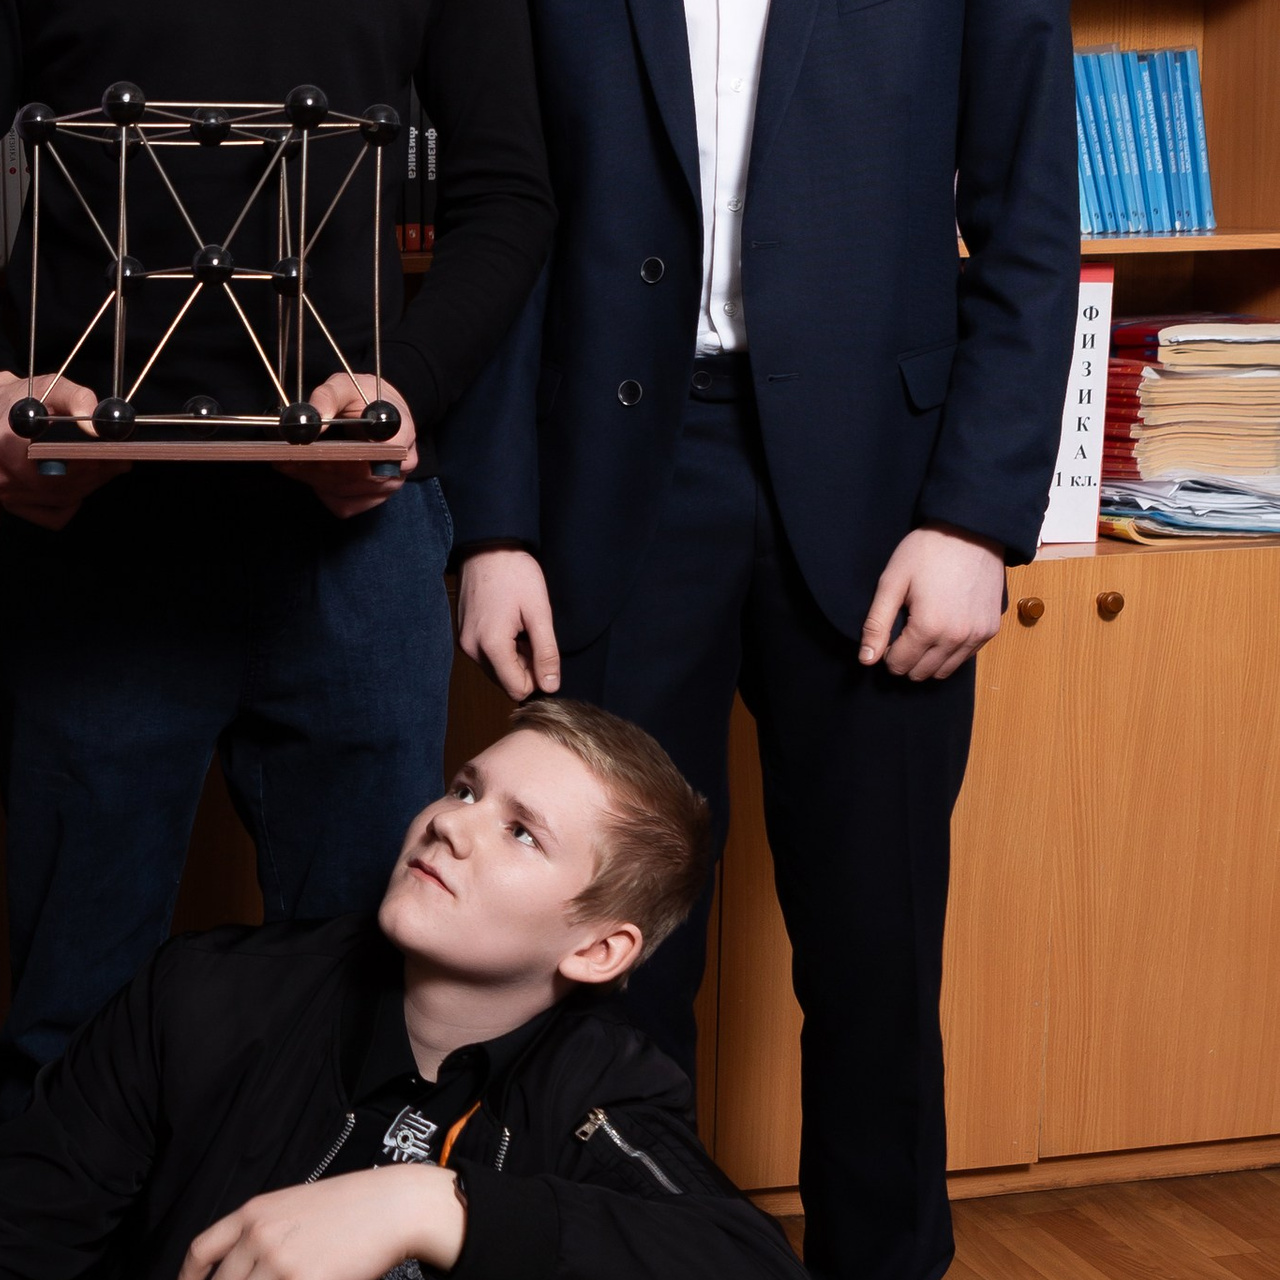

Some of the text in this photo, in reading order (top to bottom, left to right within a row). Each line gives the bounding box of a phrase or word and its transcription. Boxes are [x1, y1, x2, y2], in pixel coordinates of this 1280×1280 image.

[407, 126, 419, 179] физика
[424, 127, 438, 181] физика
[1073, 305, 1100, 460] ФИЗИКА
[1070, 474, 1097, 487] кл.
